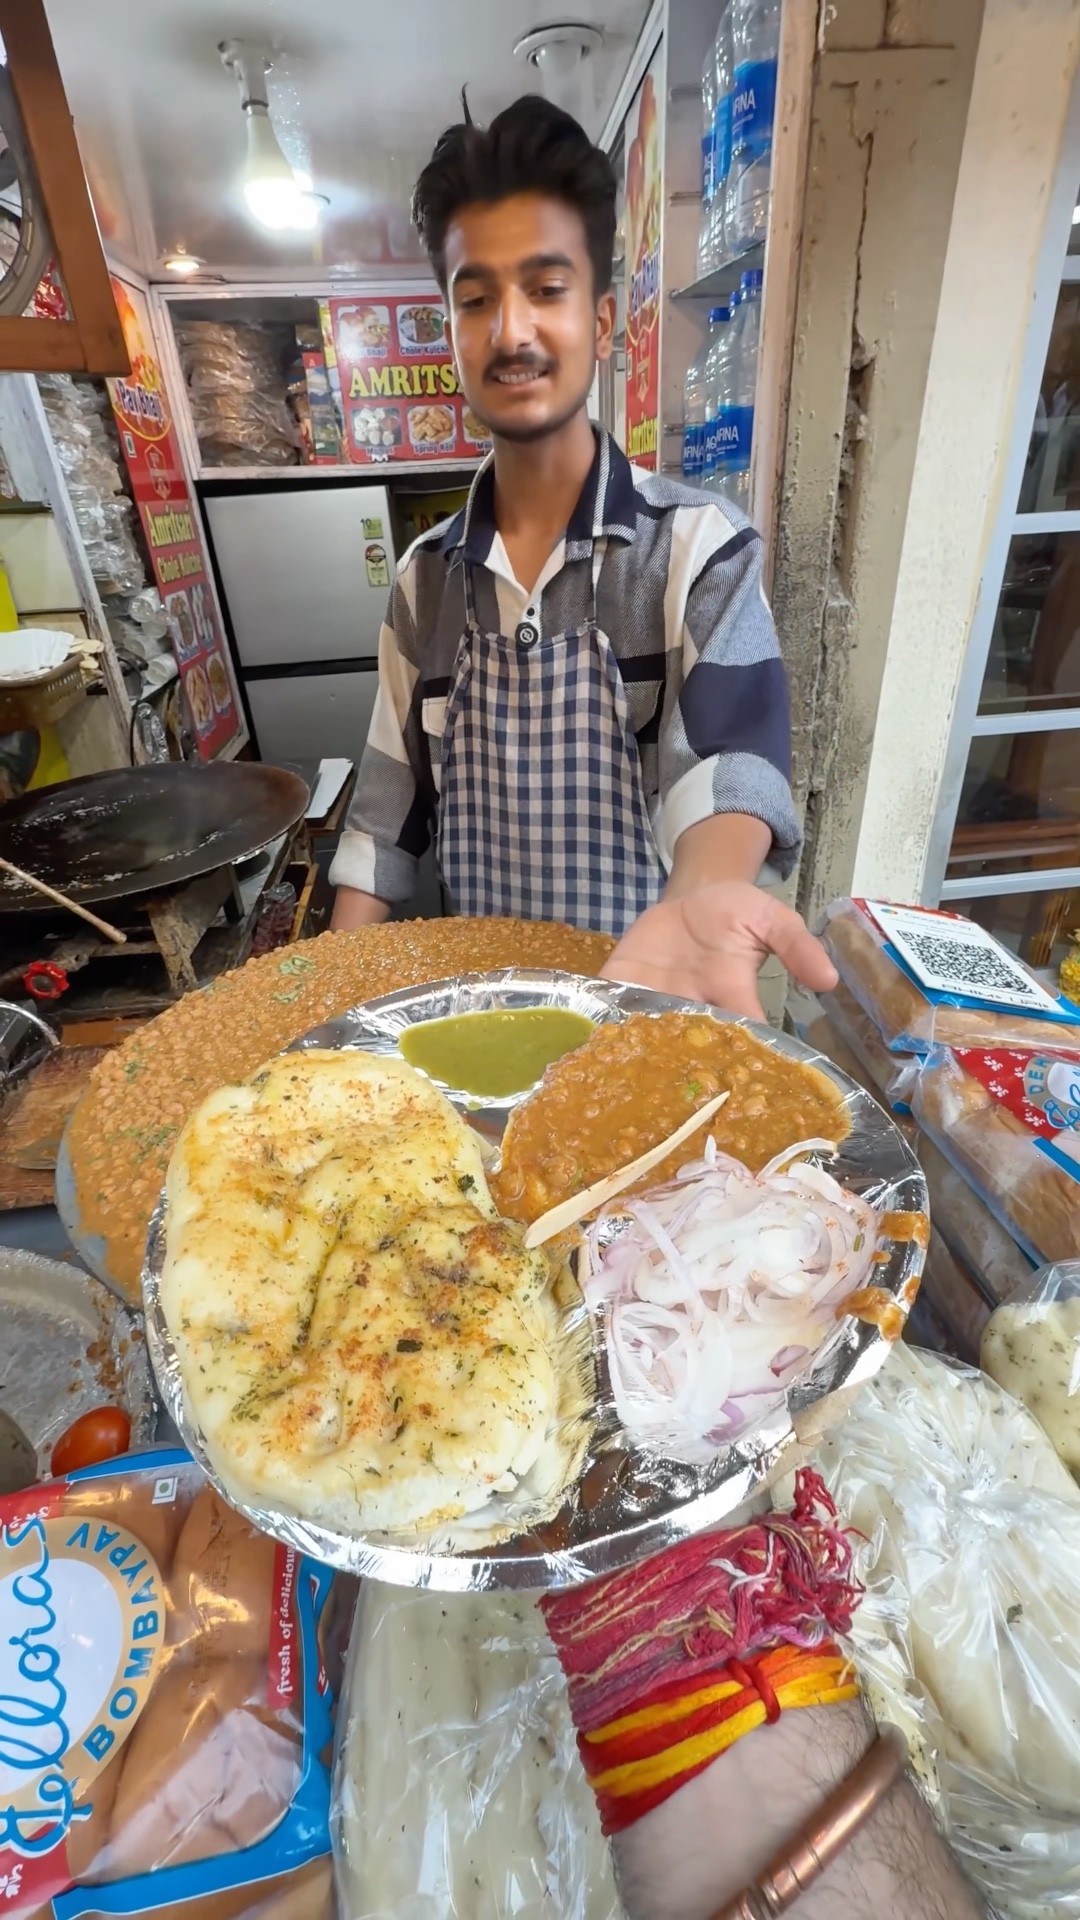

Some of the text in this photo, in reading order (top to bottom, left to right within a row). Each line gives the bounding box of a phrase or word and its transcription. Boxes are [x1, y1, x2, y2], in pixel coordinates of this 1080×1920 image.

[349, 363, 463, 398] AMRITS
[279, 1620, 294, 1640] of
[277, 1644, 294, 1695] fresh
